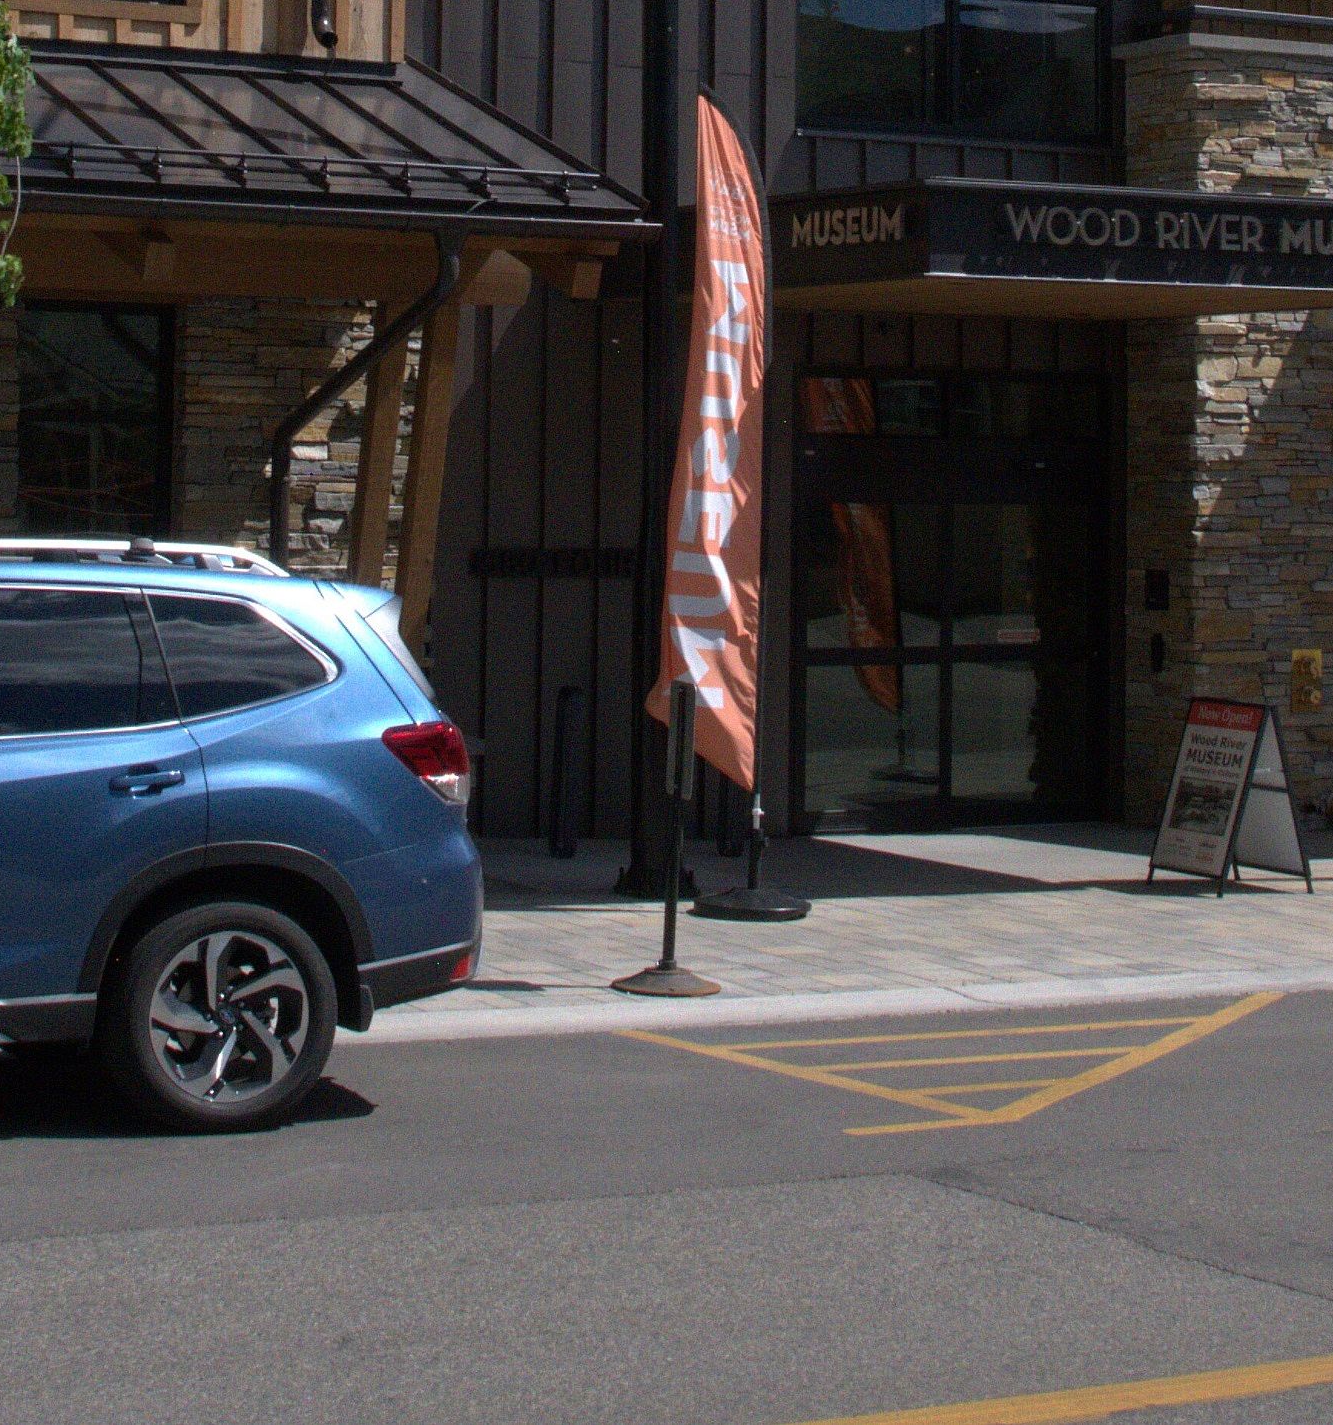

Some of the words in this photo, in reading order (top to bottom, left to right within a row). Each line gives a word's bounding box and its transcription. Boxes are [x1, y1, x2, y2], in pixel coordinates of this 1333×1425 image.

[791, 204, 905, 248] MUSEUM
[1005, 203, 1141, 247] WOOD
[1156, 210, 1265, 252] RIVER
[1197, 706, 1220, 721] New
[1221, 709, 1255, 726] Open!
[1190, 732, 1217, 746] Wood
[1218, 737, 1247, 751] River
[1185, 748, 1243, 768] MUSEUM
